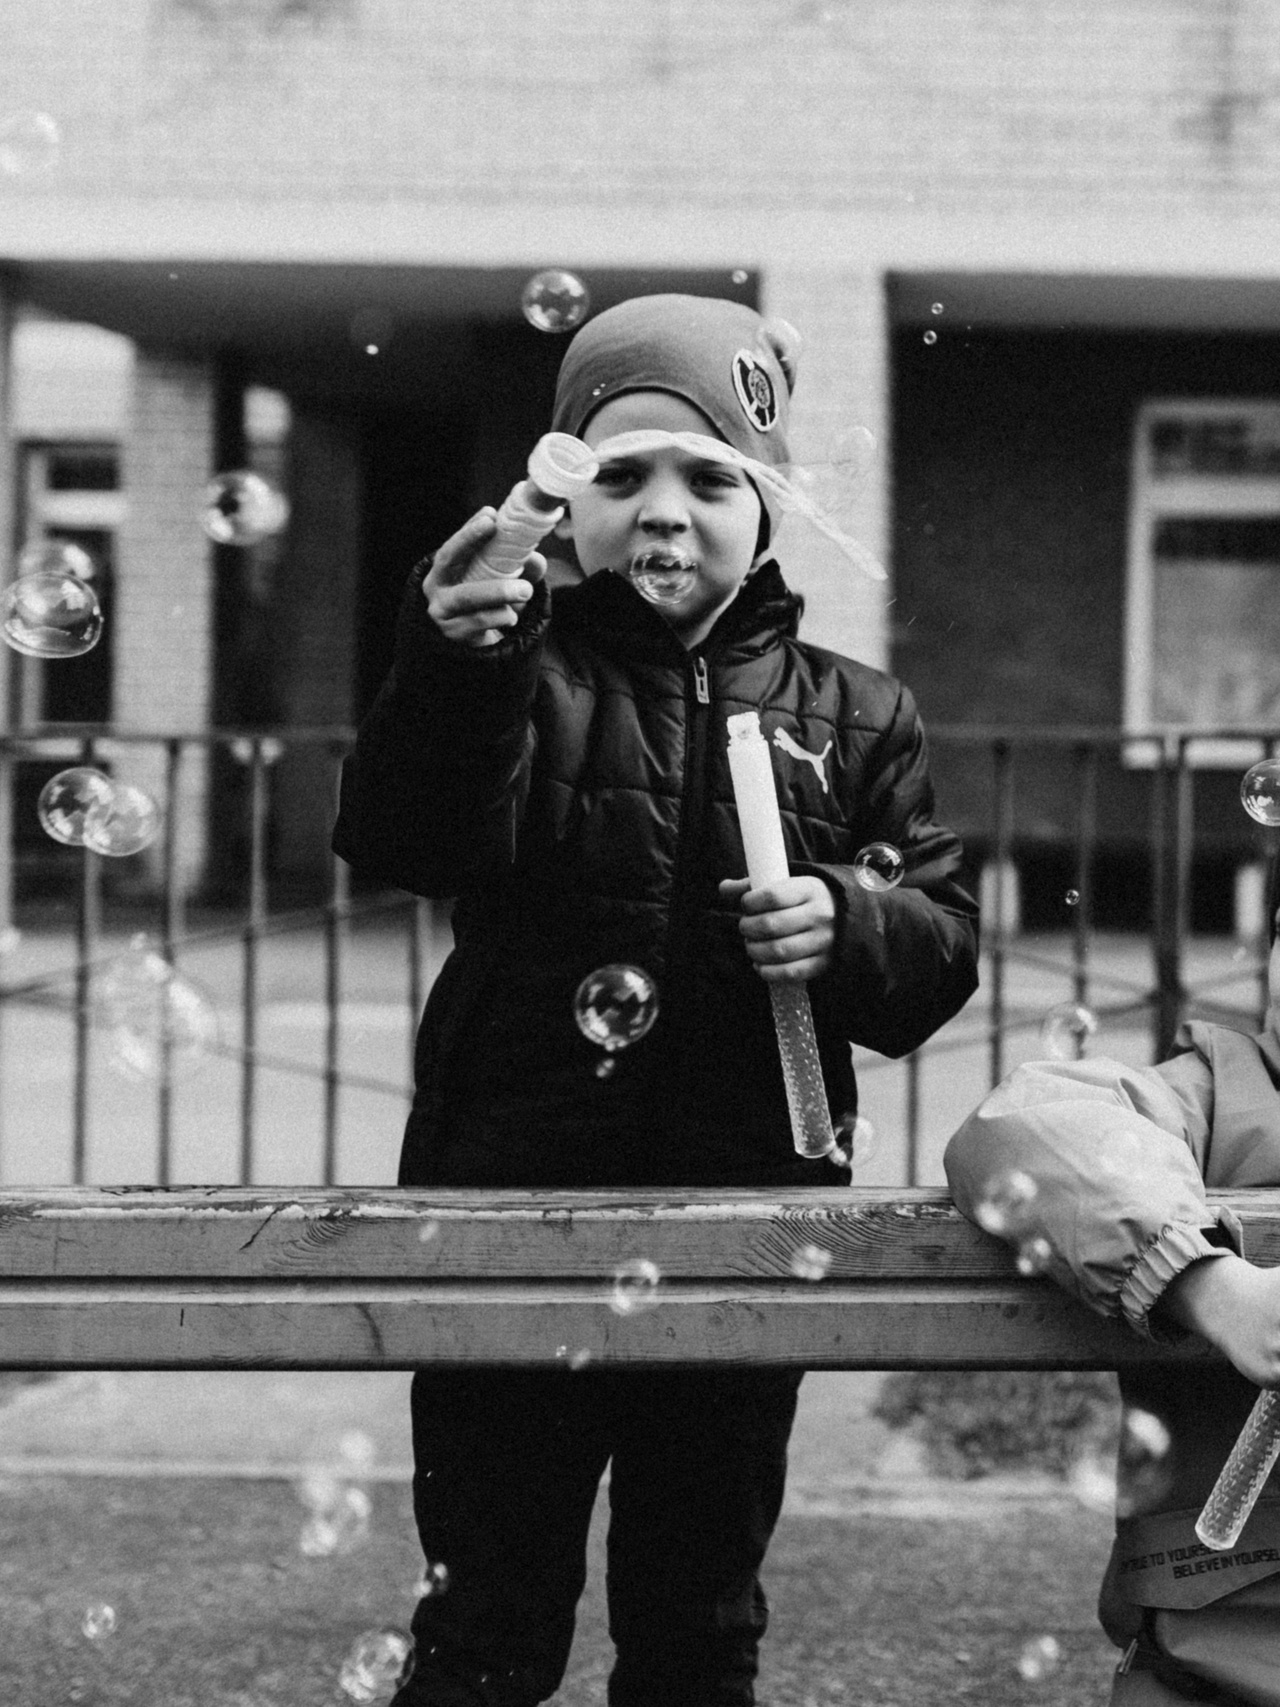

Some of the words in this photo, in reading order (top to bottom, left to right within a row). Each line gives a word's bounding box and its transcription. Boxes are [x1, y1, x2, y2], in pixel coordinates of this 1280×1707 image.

[1149, 1551, 1165, 1567] TO
[1173, 1557, 1221, 1579] BELIEVE
[1221, 1556, 1233, 1569] IN
